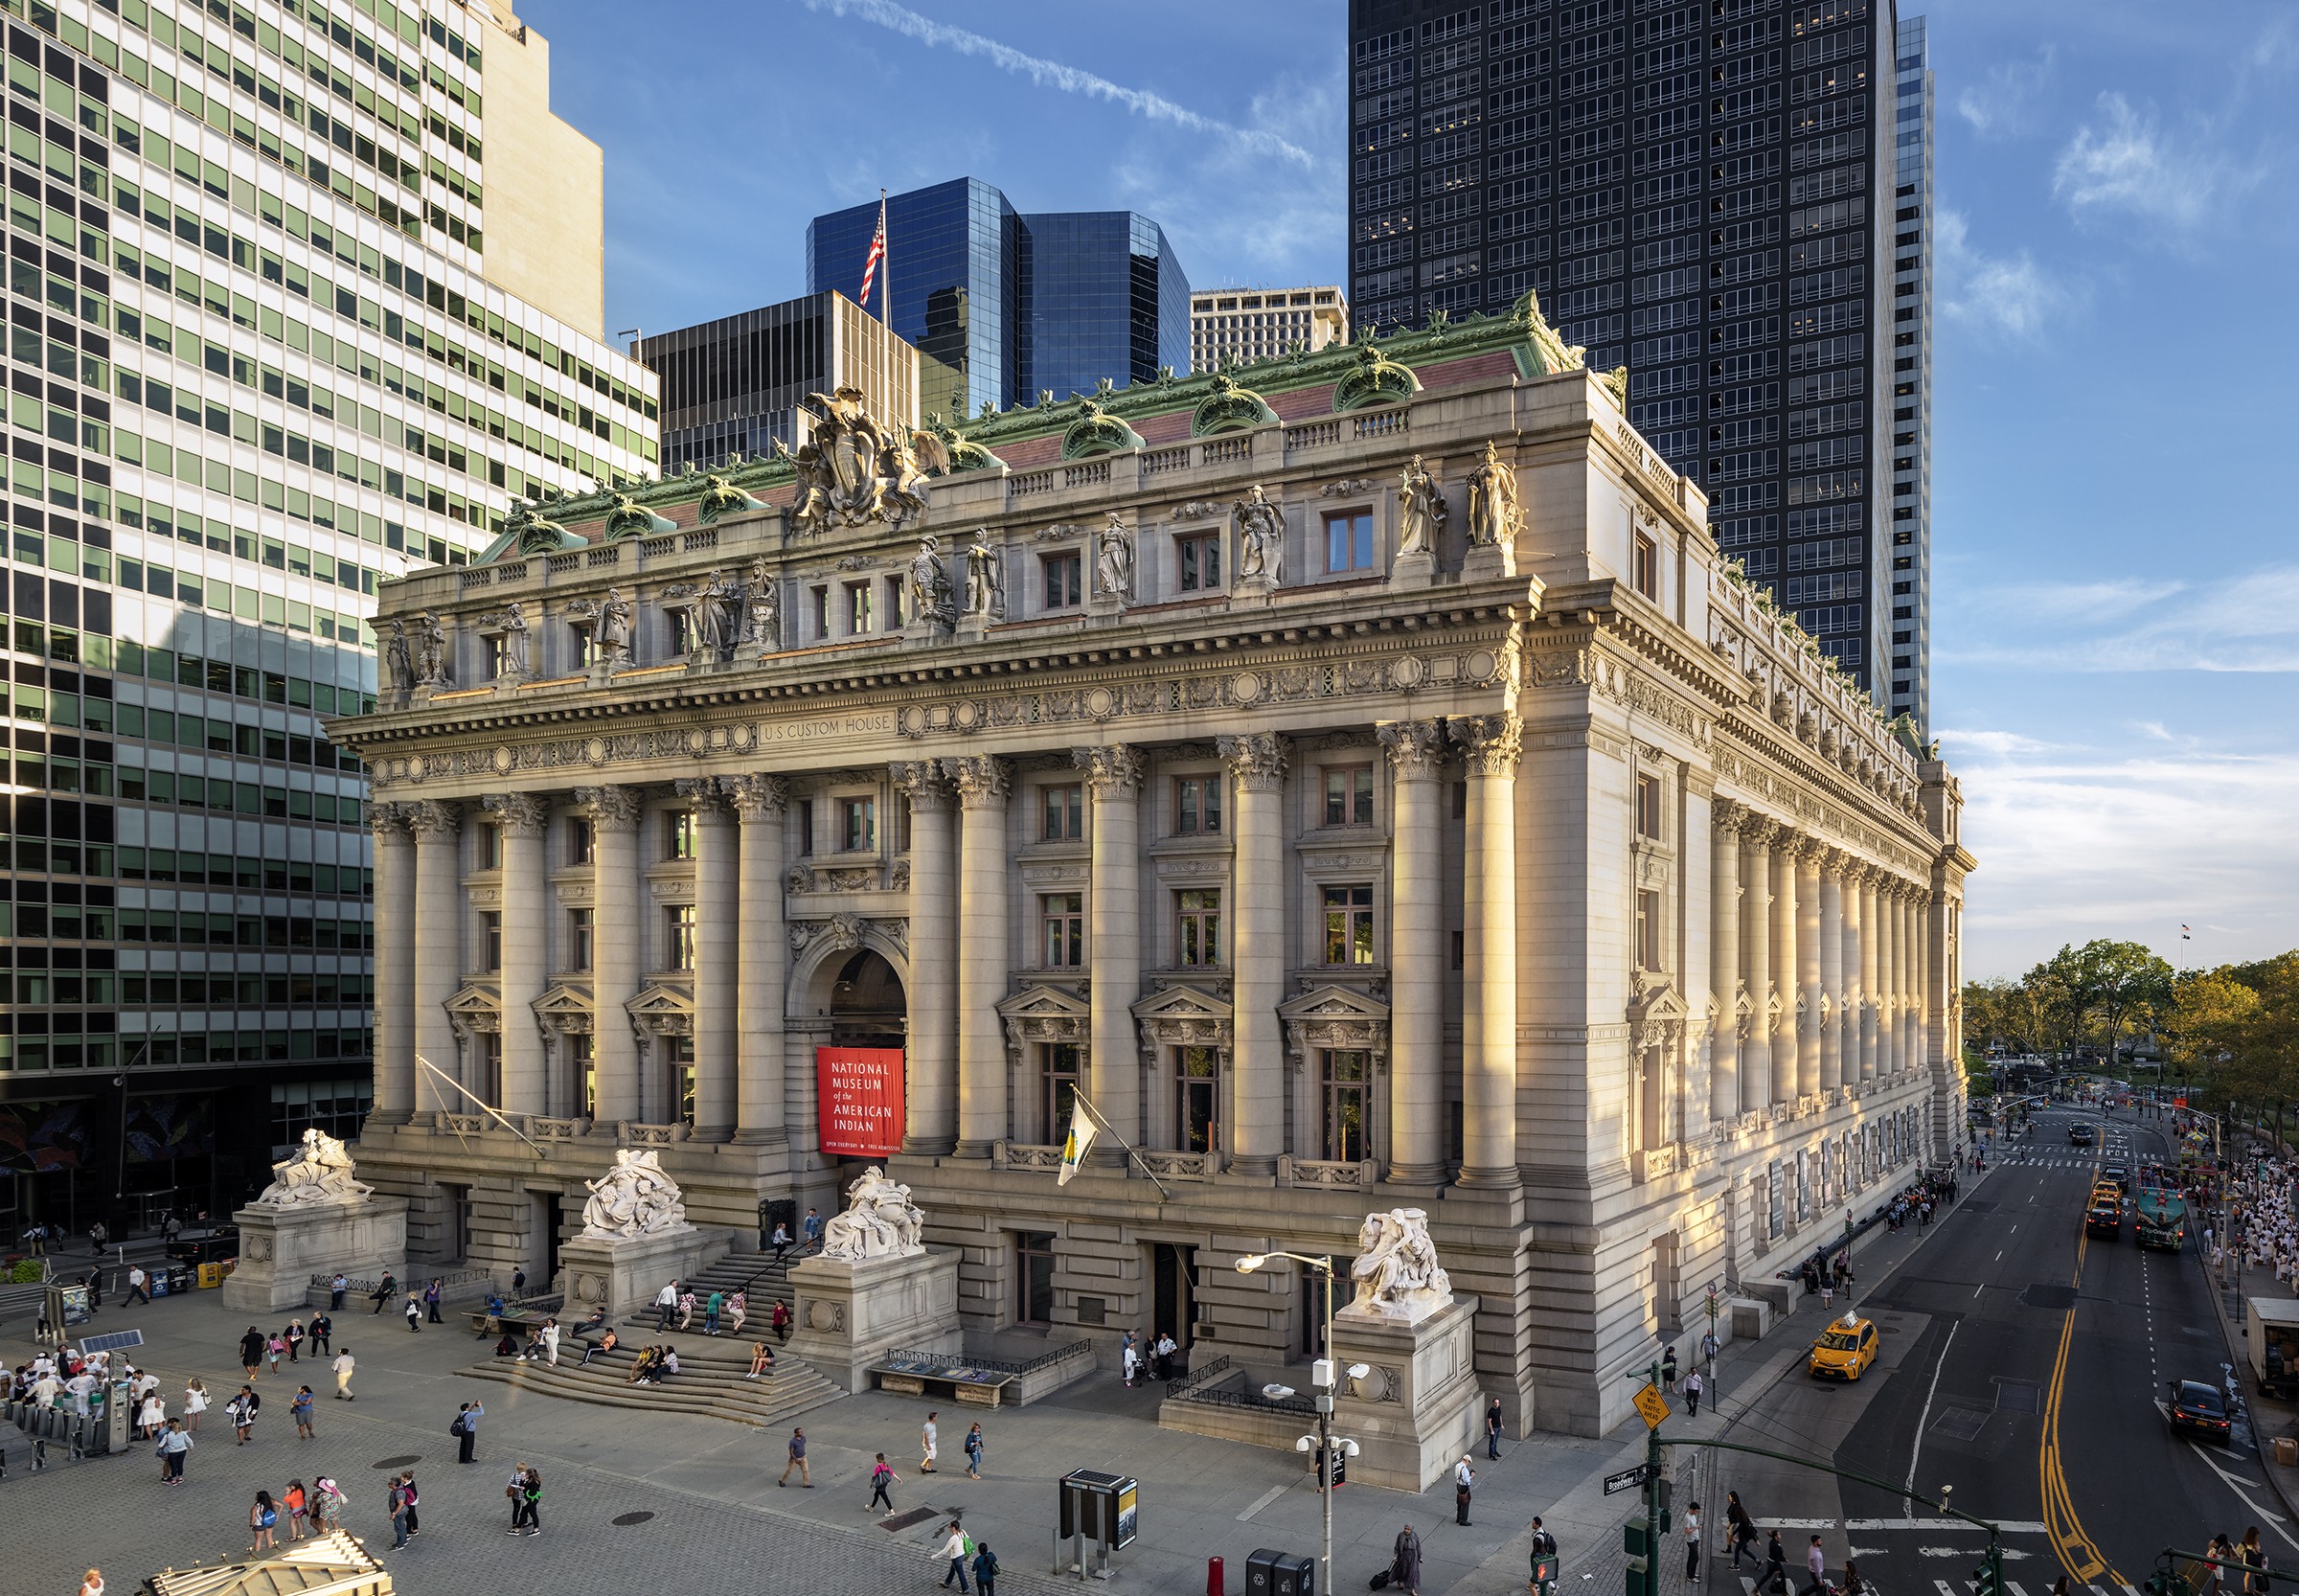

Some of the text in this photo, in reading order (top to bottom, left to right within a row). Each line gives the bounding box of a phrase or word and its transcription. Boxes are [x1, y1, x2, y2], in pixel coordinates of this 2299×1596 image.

[786, 720, 839, 739] CUSTOM
[846, 716, 890, 733] HOUSE
[831, 1062, 889, 1075] NATIONAL
[832, 1078, 881, 1090] MUSEUM
[833, 1091, 852, 1102] of the
[833, 1105, 892, 1117] AMERICAN
[834, 1119, 874, 1131] INDIAN
[1642, 1402, 1660, 1414] TRAFFIC
[1644, 1411, 1658, 1421] AHEAD
[1608, 1476, 1634, 1490] Broadway
